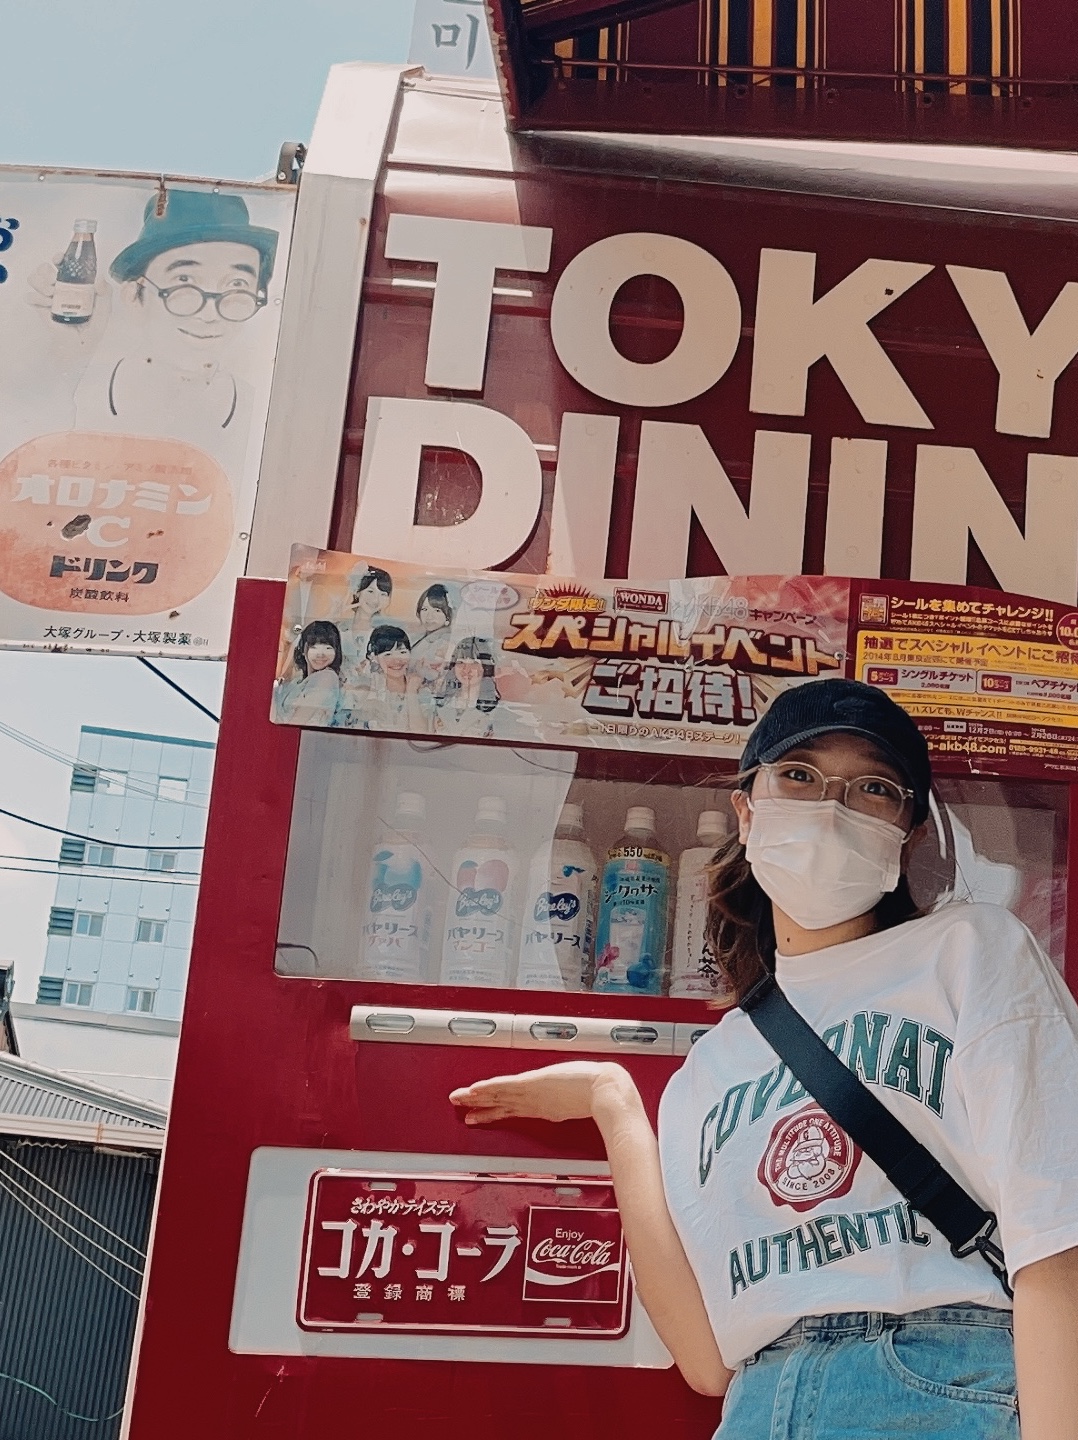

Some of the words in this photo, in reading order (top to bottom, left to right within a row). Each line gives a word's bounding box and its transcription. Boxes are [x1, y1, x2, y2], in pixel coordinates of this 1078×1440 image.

[432, 0, 484, 70] 미
[11, 473, 213, 516] オロナミン
[86, 515, 131, 548] C
[50, 555, 159, 584] ドリンク
[69, 588, 130, 602] 炭酸飲料
[619, 591, 664, 607] WONDA
[749, 608, 817, 625] キャンペーン
[502, 612, 841, 677] スペシャルイベント
[901, 669, 974, 682] シングルチケット
[582, 659, 758, 724] ご招待!
[623, 846, 644, 858] 550
[448, 926, 505, 945] バヤリース
[781, 1175, 809, 1191] SINCE
[349, 1196, 456, 1217] さわやかテイスティ
[555, 1227, 585, 1242] Enjoy
[317, 1218, 522, 1282] コカ・コーラ
[531, 1237, 616, 1267] Coca-Cola
[729, 1201, 932, 1300] AUTHENTIC
[353, 1283, 466, 1302] 登録商標
